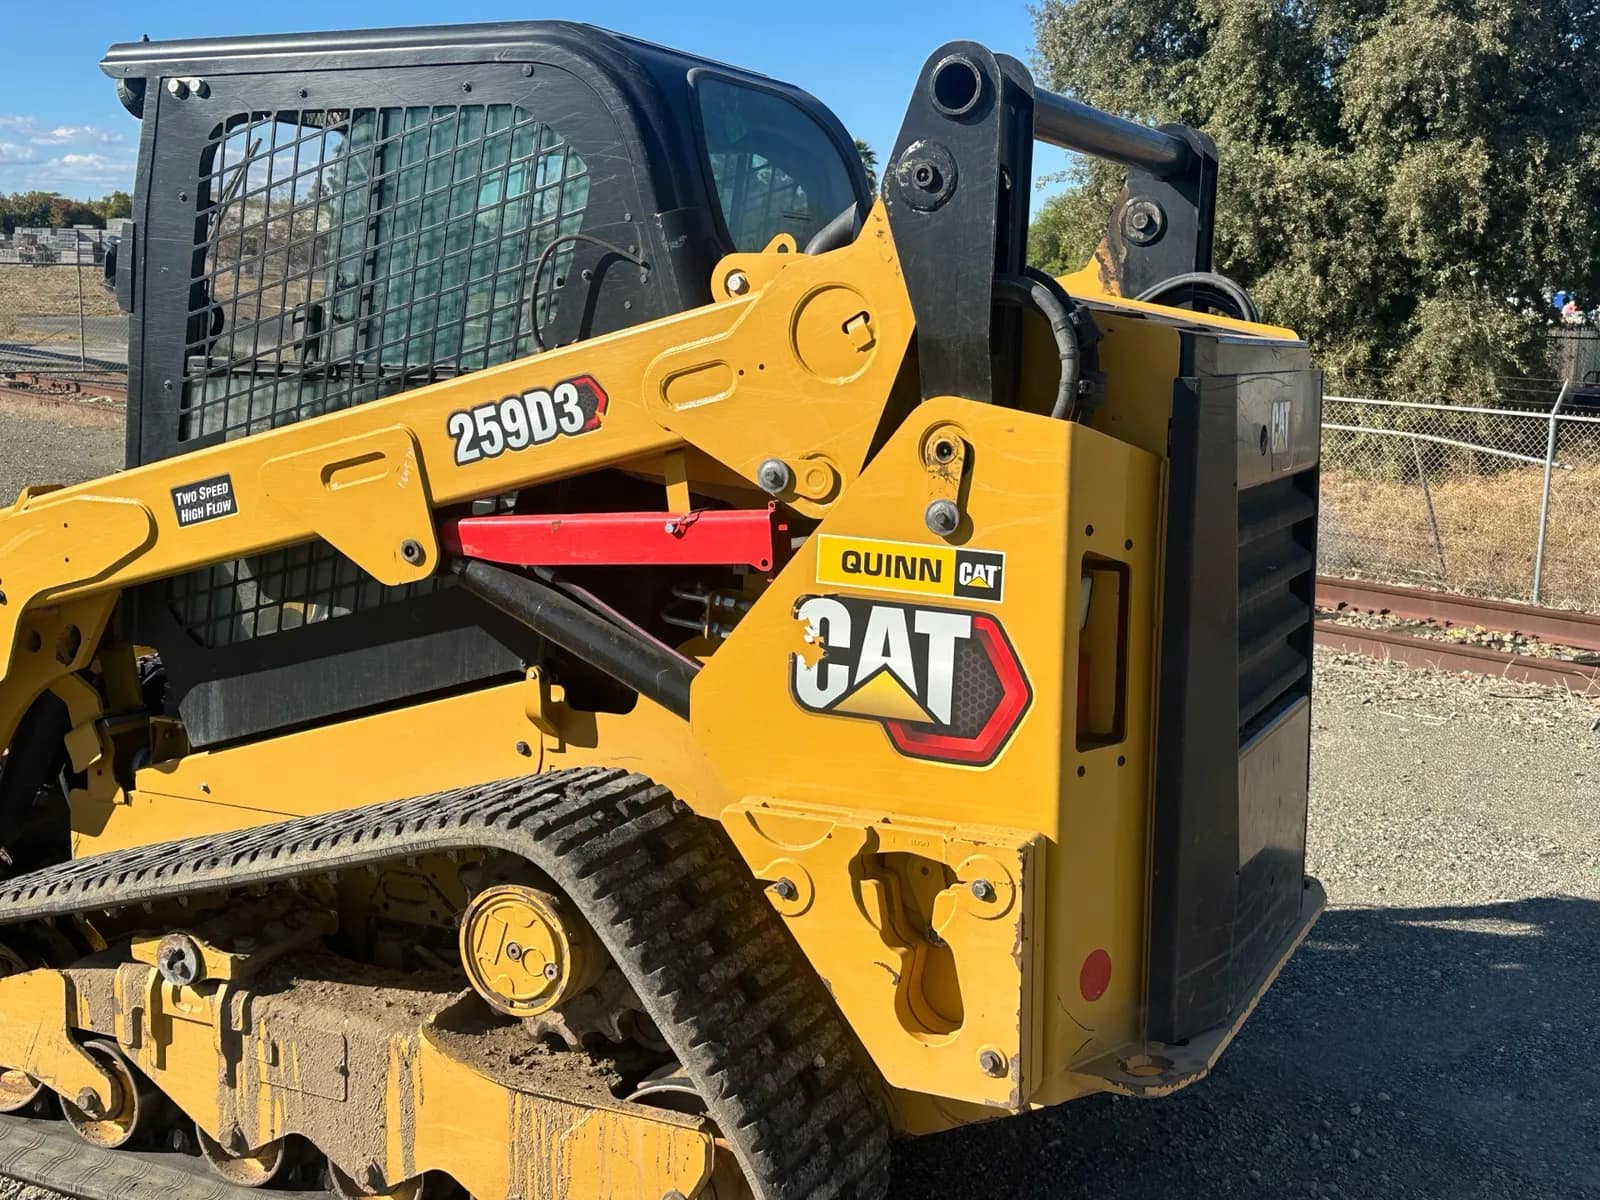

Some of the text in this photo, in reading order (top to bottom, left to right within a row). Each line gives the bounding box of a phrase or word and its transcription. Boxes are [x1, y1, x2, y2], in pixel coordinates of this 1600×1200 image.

[449, 383, 585, 463] 259D3
[1272, 401, 1291, 449] CAT
[841, 550, 997, 589] QUINN CAT
[795, 597, 972, 726] CAT
